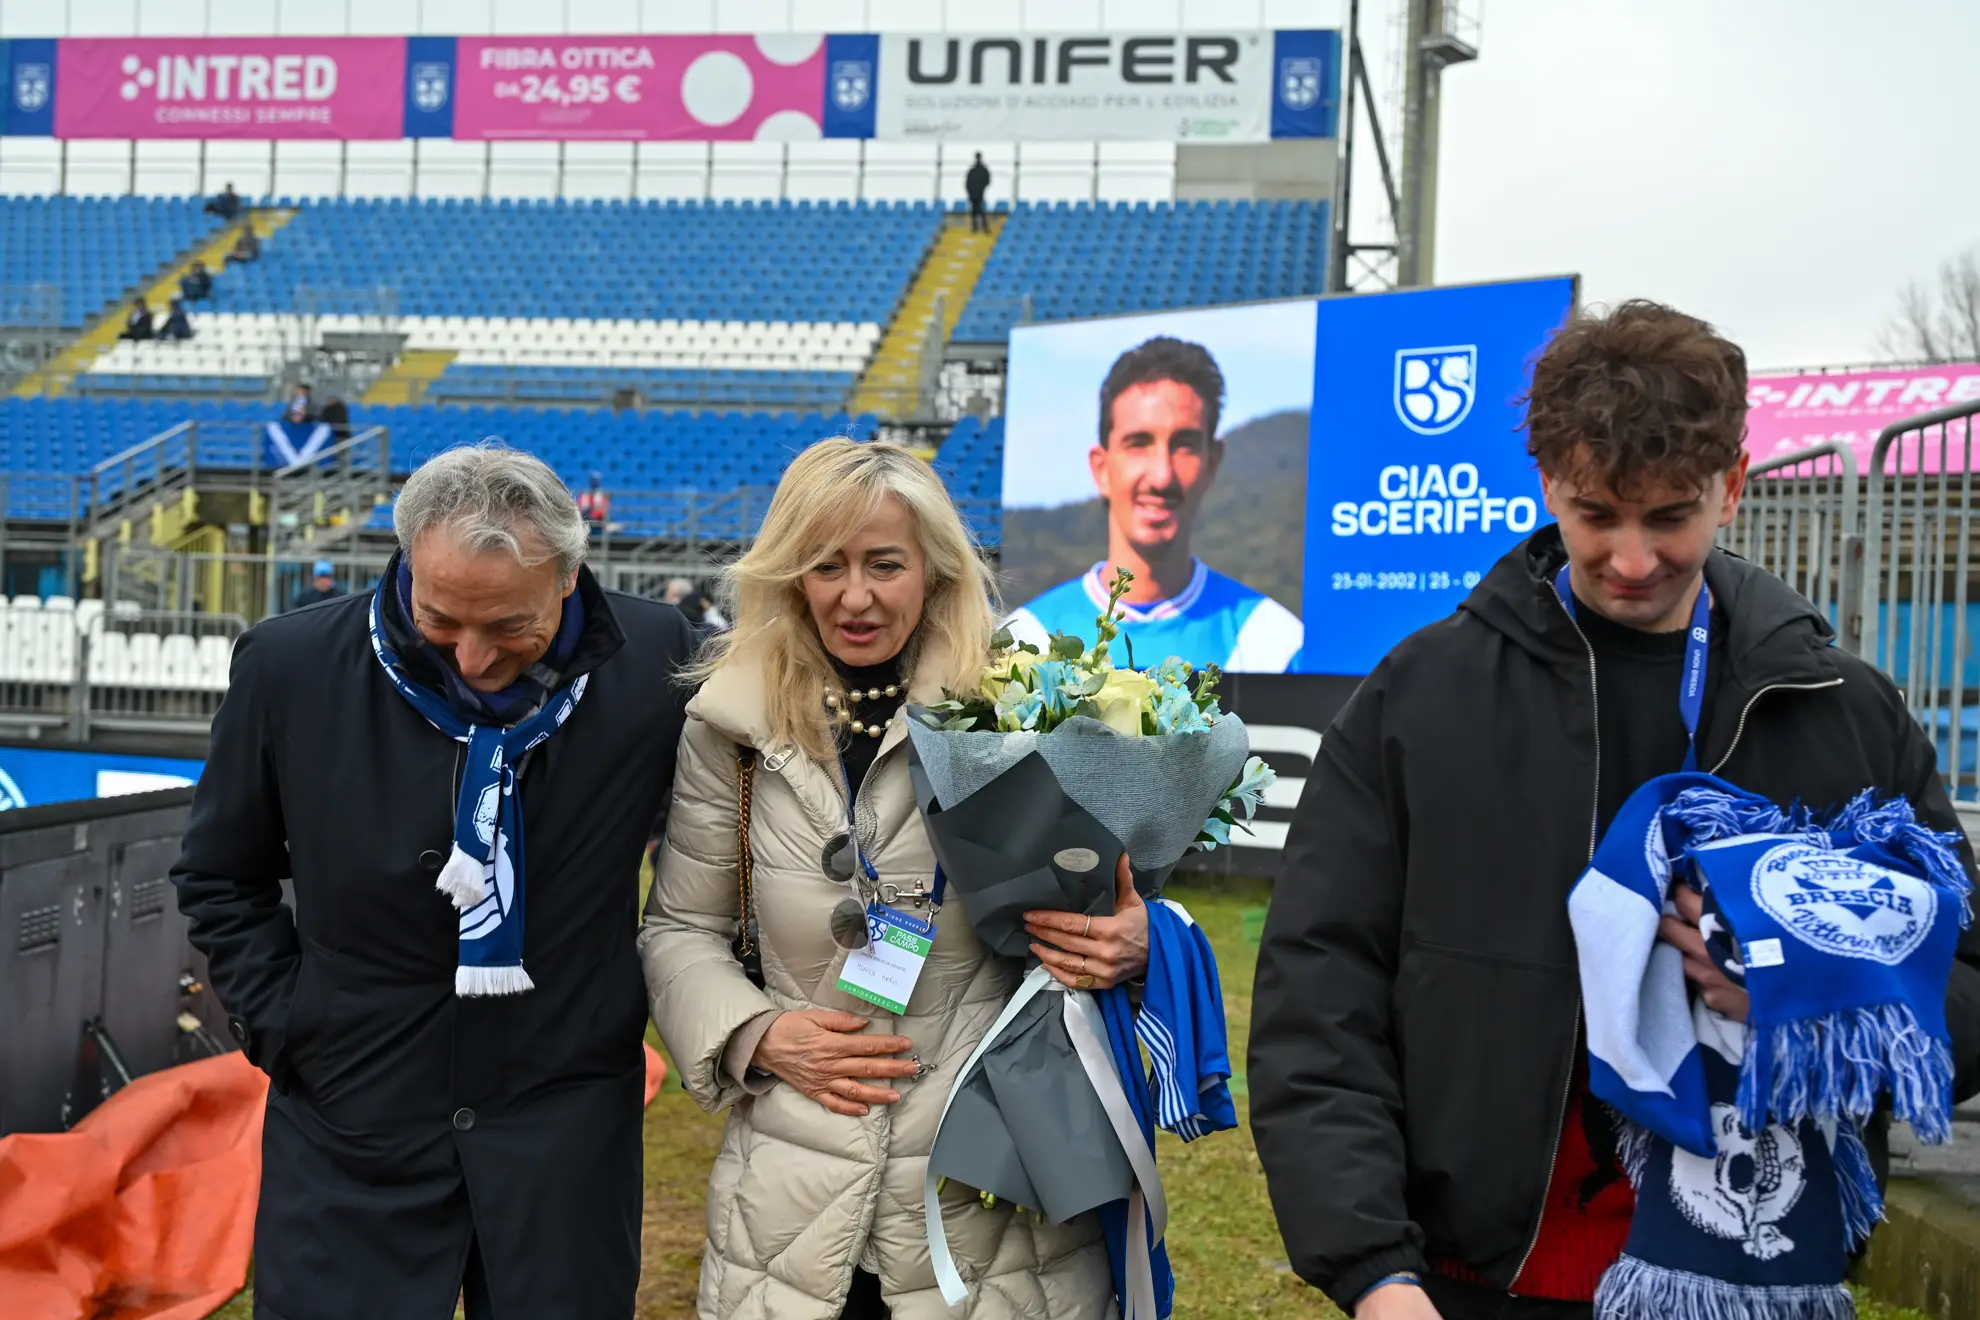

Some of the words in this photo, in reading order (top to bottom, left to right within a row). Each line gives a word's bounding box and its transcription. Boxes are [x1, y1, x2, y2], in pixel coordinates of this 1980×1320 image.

[480, 47, 558, 70] FIBRA
[561, 46, 655, 70] OTTICA
[907, 37, 1239, 85] UNIFER
[157, 55, 338, 101] INTRED
[519, 75, 611, 107] 24,95
[614, 75, 642, 102] €
[155, 107, 251, 124] CONNESSI
[256, 107, 332, 124] SEMPRE
[1379, 463, 1488, 501] CIAO,
[1331, 496, 1537, 536] SCERIFFO
[1785, 889, 1914, 916] BRESCIA
[889, 935, 920, 953] CAMPO
[896, 930, 919, 945] PASS
